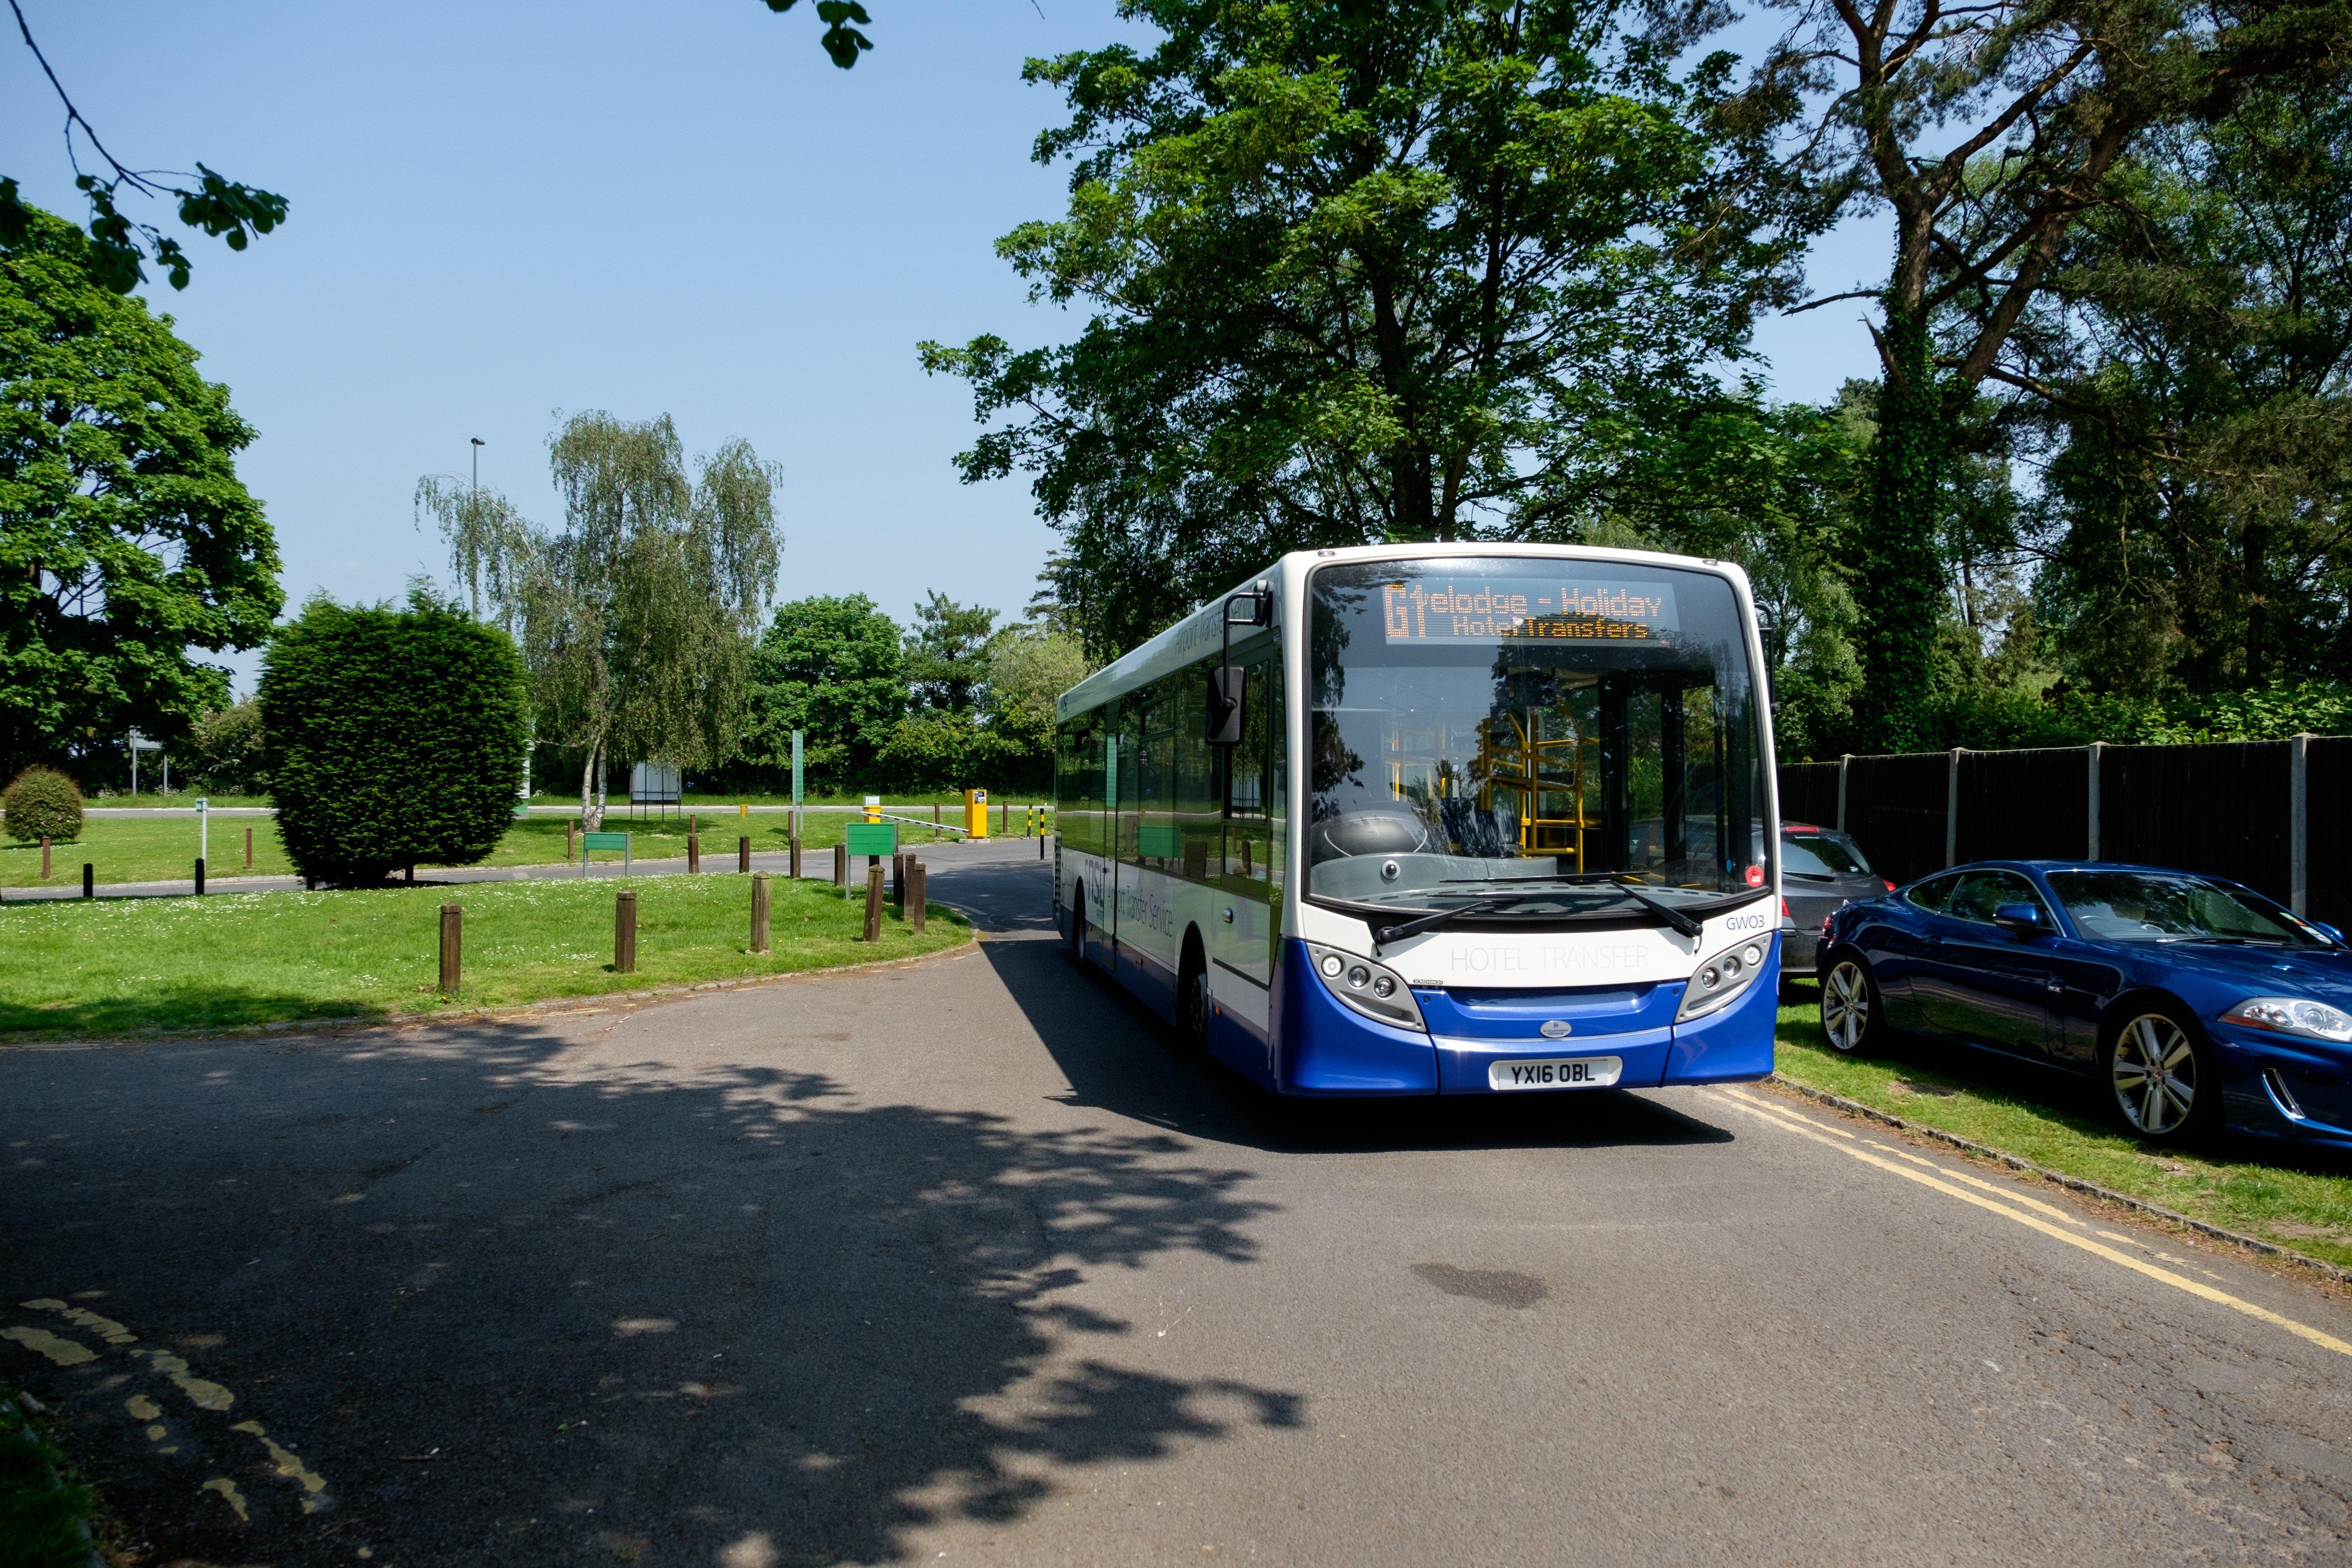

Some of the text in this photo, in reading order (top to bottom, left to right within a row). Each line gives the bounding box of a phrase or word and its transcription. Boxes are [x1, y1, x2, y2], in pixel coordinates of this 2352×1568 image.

[1561, 587, 1661, 616] Holiday
[1200, 601, 1224, 644] Transfe
[1453, 615, 1648, 638] Hotel Transfers
[1127, 885, 1148, 925] Transfer
[1149, 894, 1173, 938] Service
[1452, 945, 1649, 971] HOTEL TRANSFER
[1511, 1064, 1595, 1084] YX16 OBL
